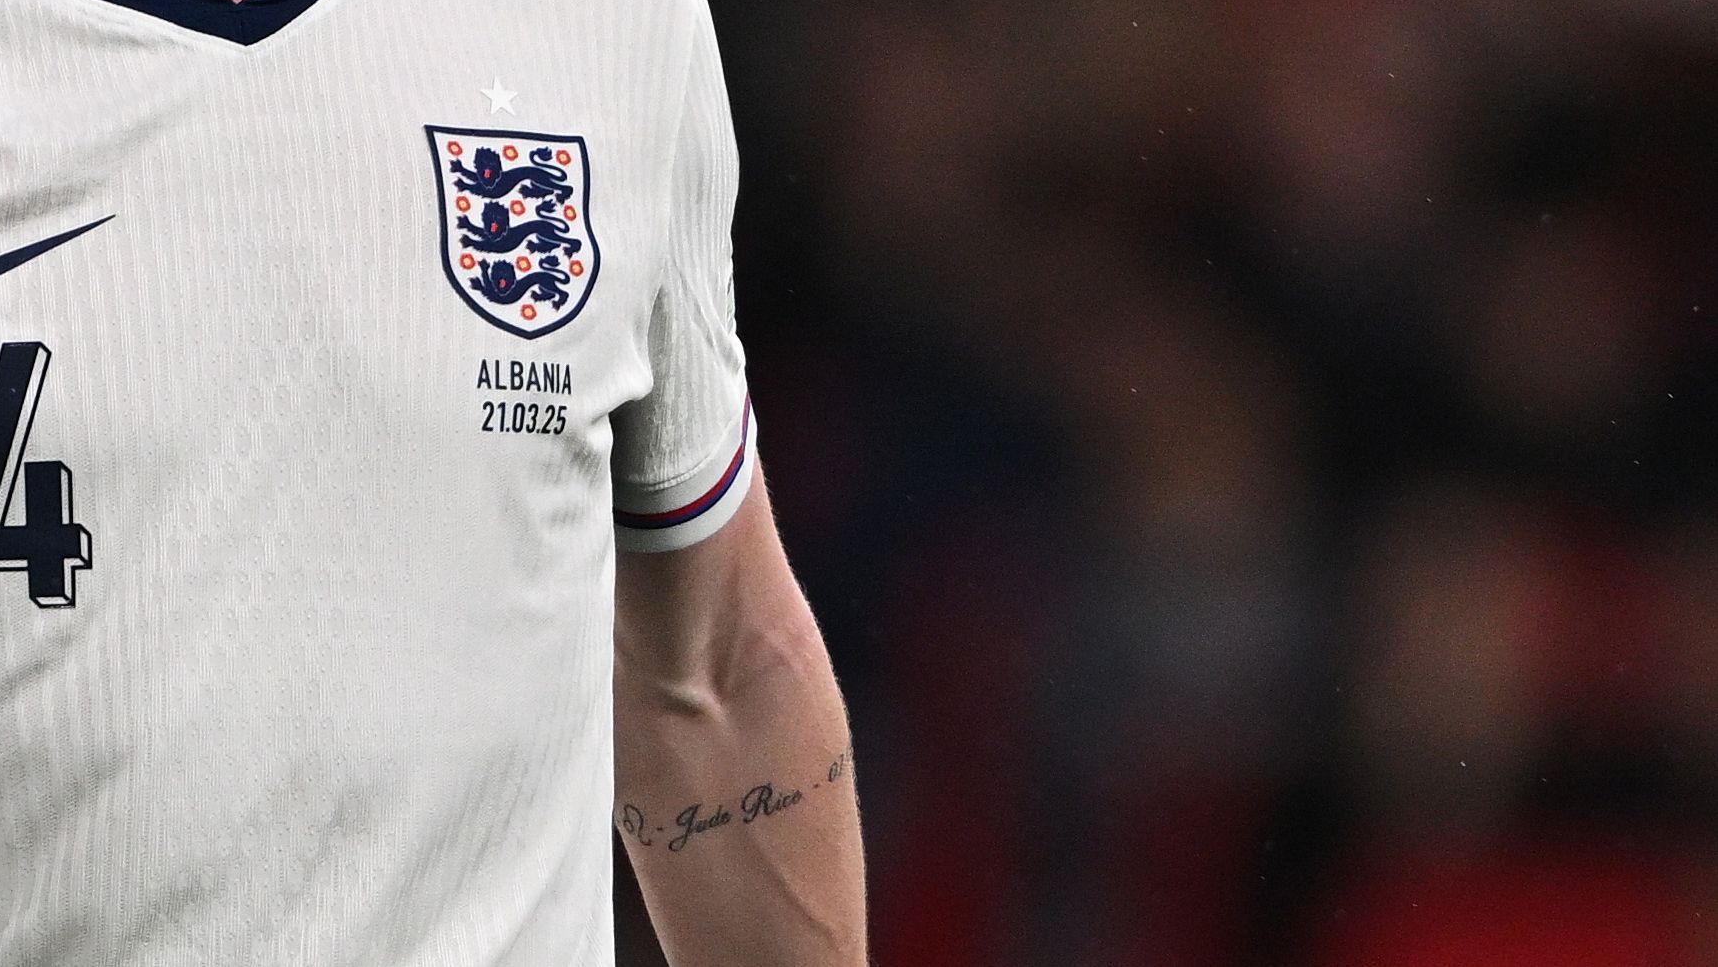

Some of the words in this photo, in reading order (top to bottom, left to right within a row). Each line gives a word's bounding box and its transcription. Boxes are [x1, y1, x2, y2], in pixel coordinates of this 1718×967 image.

[477, 359, 571, 395] ALBANIA
[482, 401, 567, 434] 21.03.25
[668, 803, 732, 852] Jude
[741, 782, 803, 824] Rice
